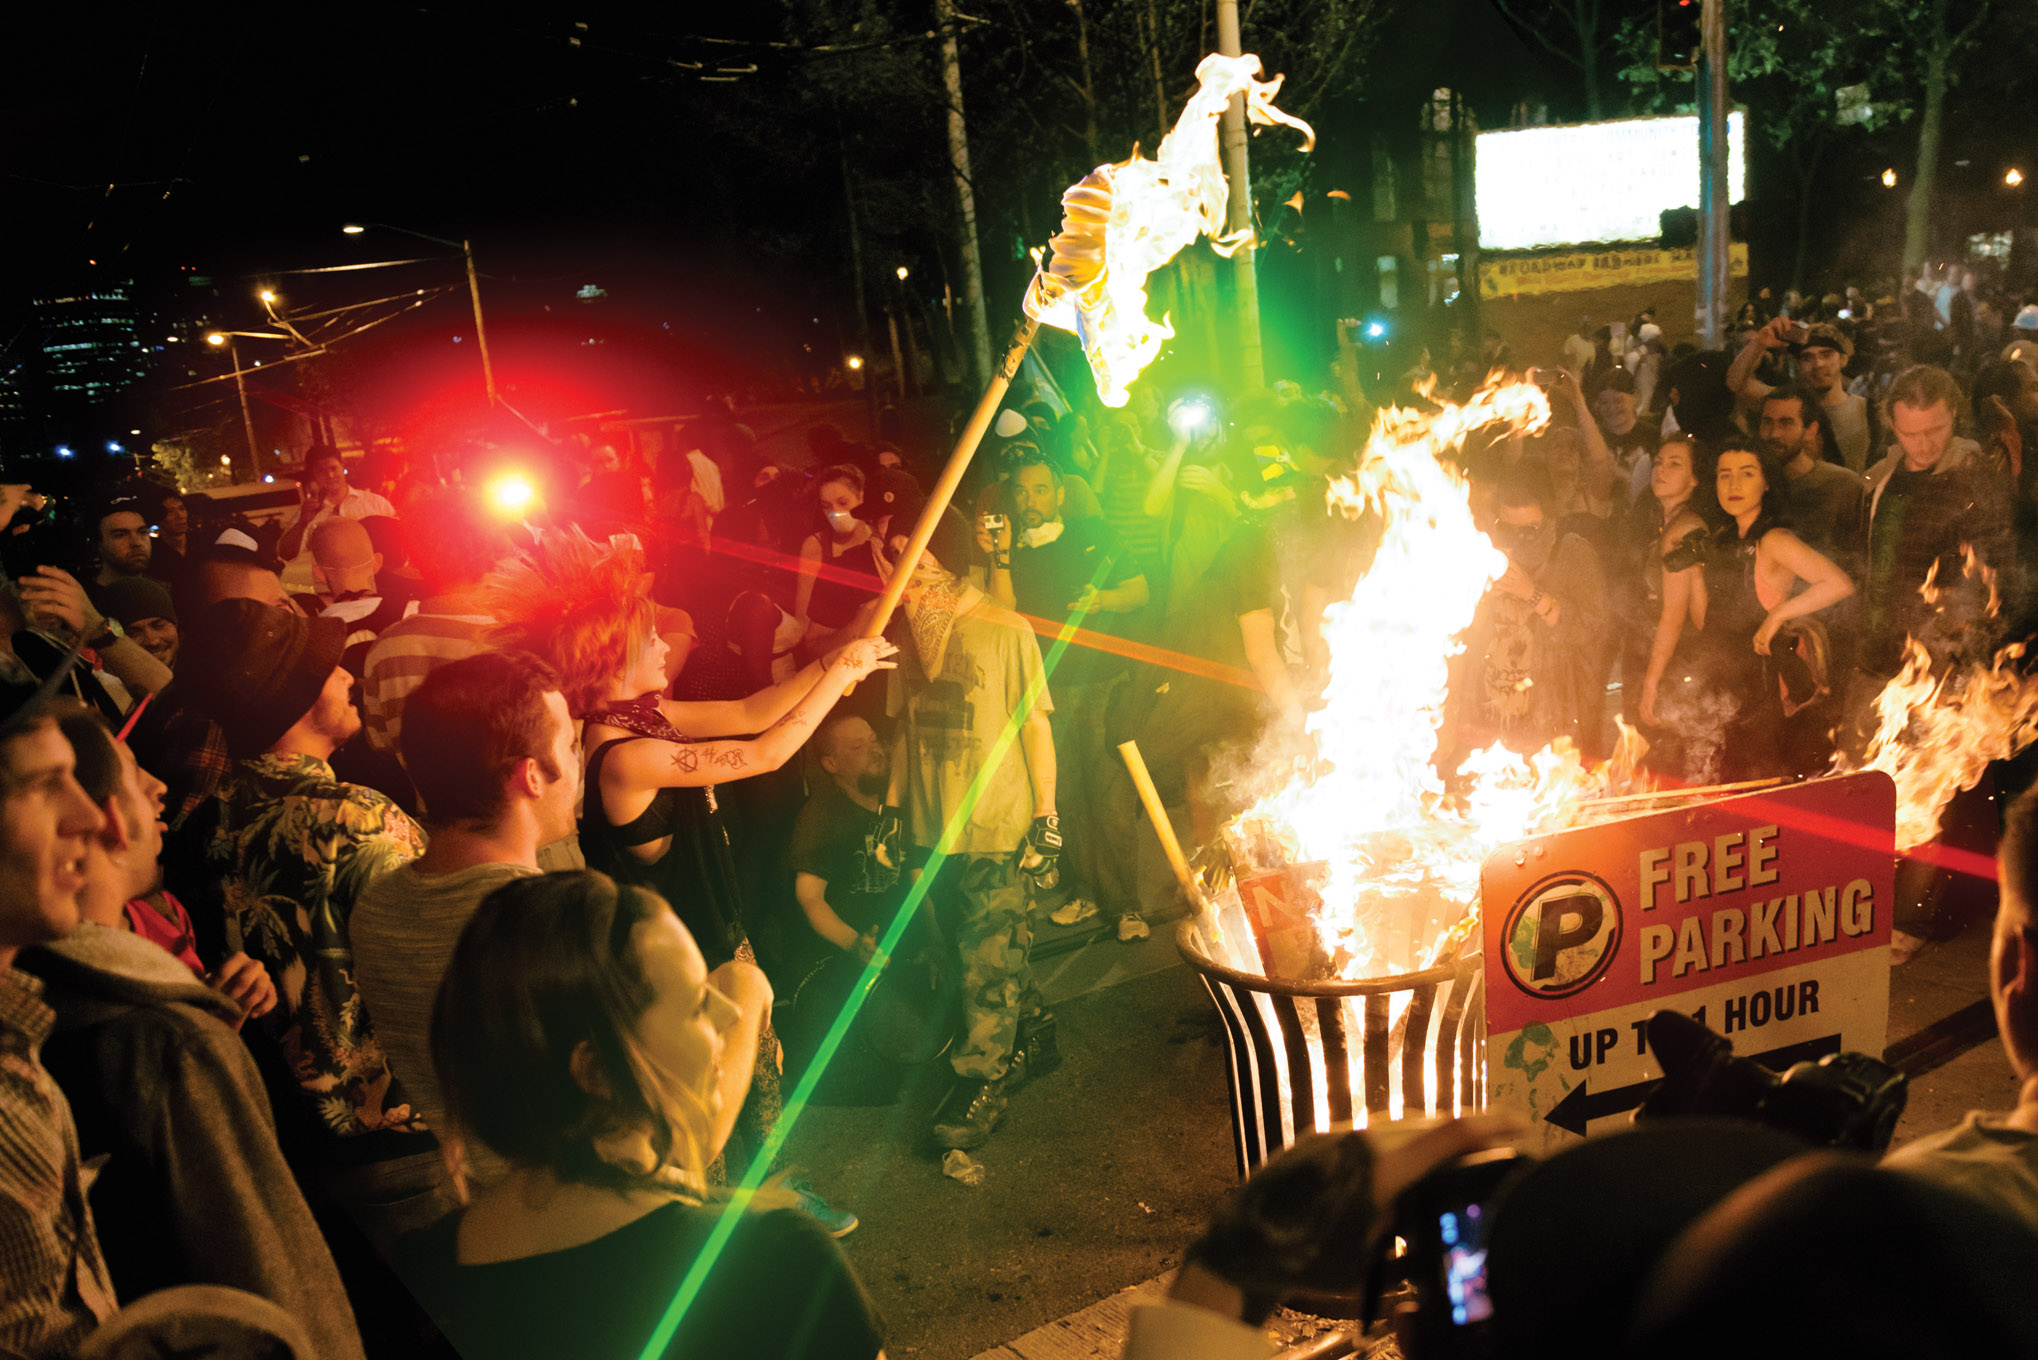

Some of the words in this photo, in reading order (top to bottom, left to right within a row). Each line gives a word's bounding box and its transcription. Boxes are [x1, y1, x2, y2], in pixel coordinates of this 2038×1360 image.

[1639, 824, 1780, 912] FREE
[1530, 891, 1604, 982] P
[1640, 878, 1875, 985] PARKING
[1569, 1027, 1618, 1070] UP
[1631, 1019, 1649, 1055] T
[1724, 979, 1820, 1034] HOUR
